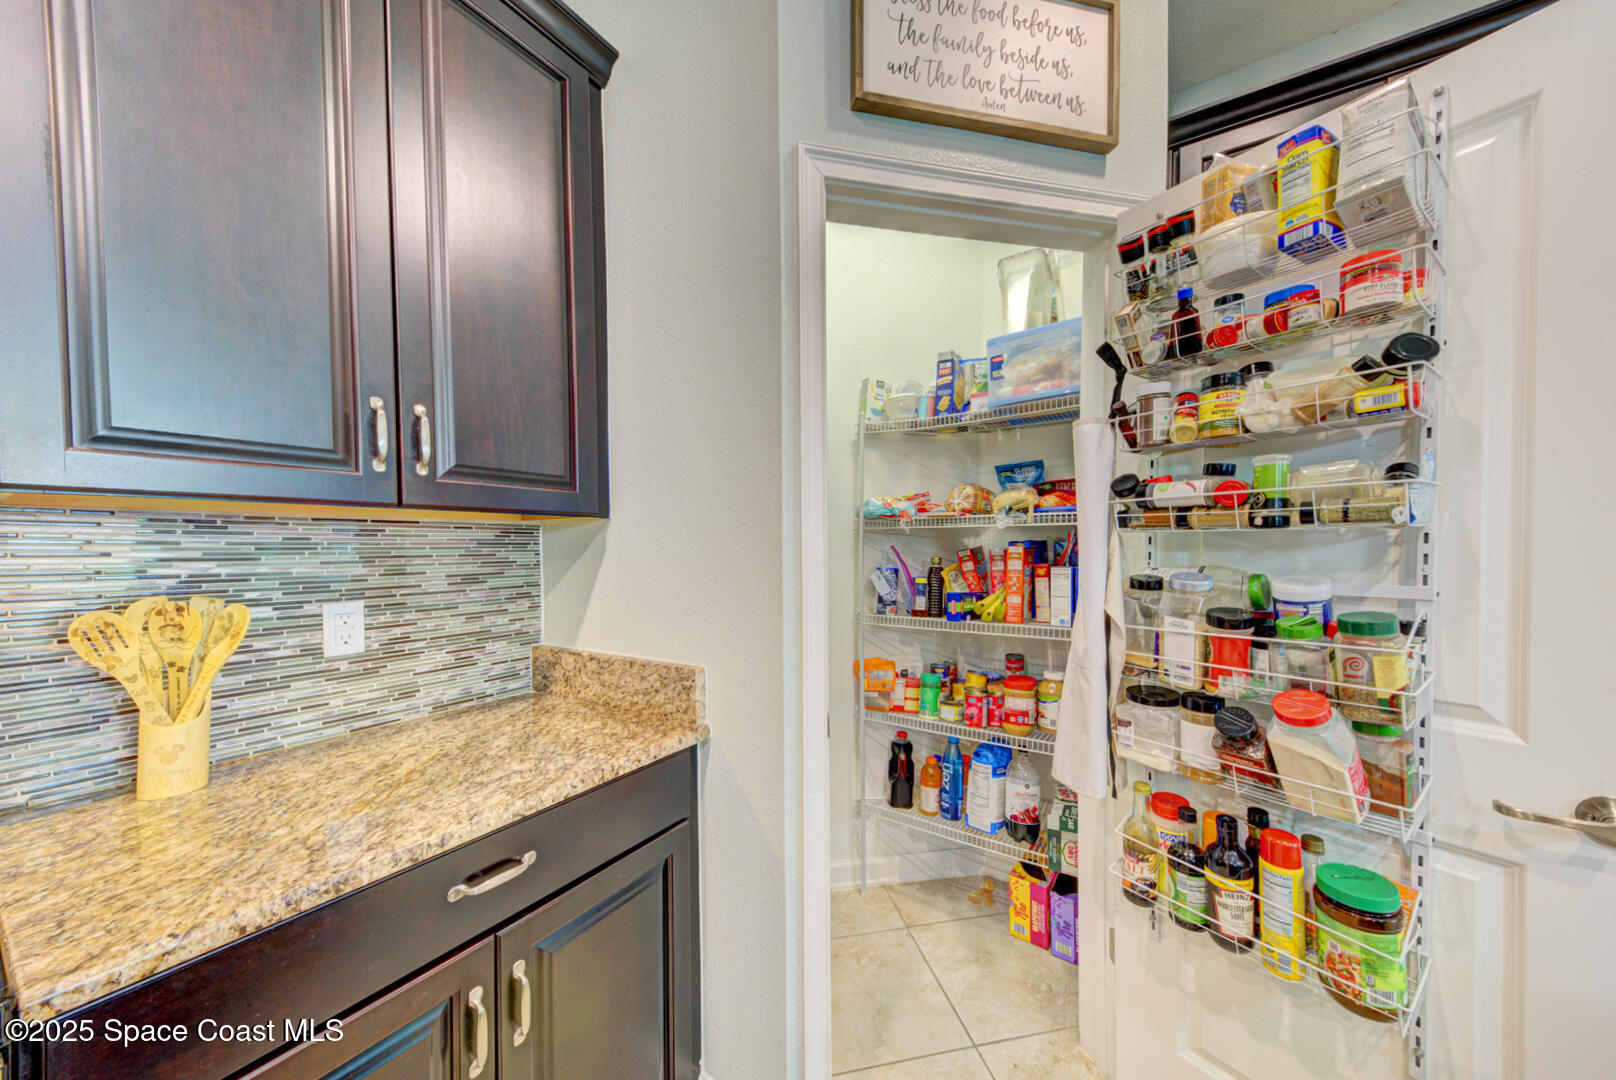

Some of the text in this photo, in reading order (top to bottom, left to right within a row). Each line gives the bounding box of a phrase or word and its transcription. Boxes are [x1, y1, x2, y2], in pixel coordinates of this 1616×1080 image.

[887, 9, 1073, 80] the family beside us,
[972, 0, 1008, 28] food
[1012, 5, 1062, 42] before
[1065, 25, 1087, 48] us,
[887, 55, 921, 83] and
[962, 63, 997, 94] love
[999, 70, 1063, 109] between
[981, 96, 1006, 112] Amen
